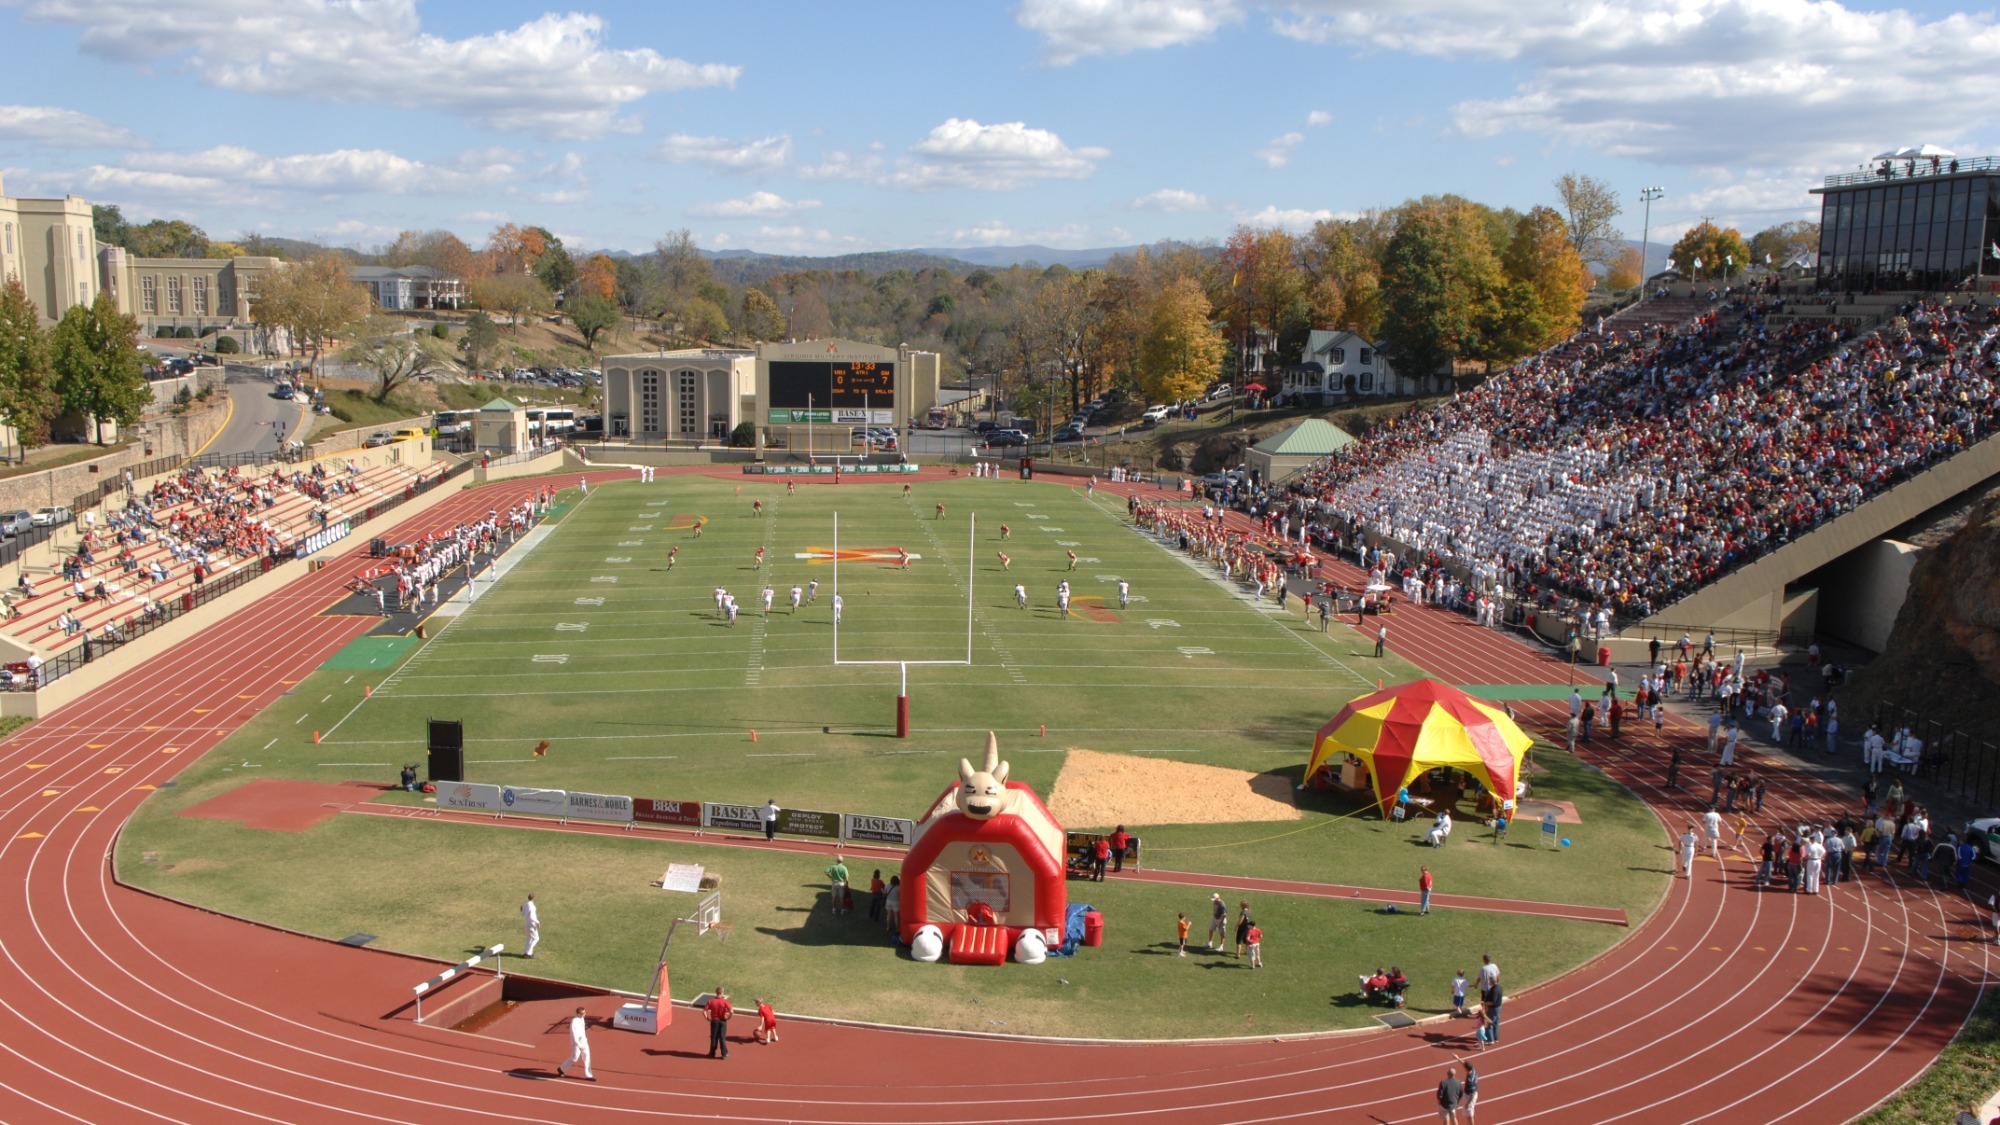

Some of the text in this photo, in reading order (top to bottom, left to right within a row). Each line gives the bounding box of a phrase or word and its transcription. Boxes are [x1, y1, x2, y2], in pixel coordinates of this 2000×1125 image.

[1840, 317, 1861, 326] FIELD
[837, 376, 844, 384] 0
[882, 376, 888, 384] 7
[652, 800, 683, 813] BB&T
[711, 805, 760, 820] BASE-X
[791, 812, 822, 820] DEPLOY
[712, 818, 761, 829] Expedition Shelters
[789, 822, 824, 830] PROTECT
[852, 817, 903, 832] BASE-X
[853, 830, 903, 842] Expedition Shelters
